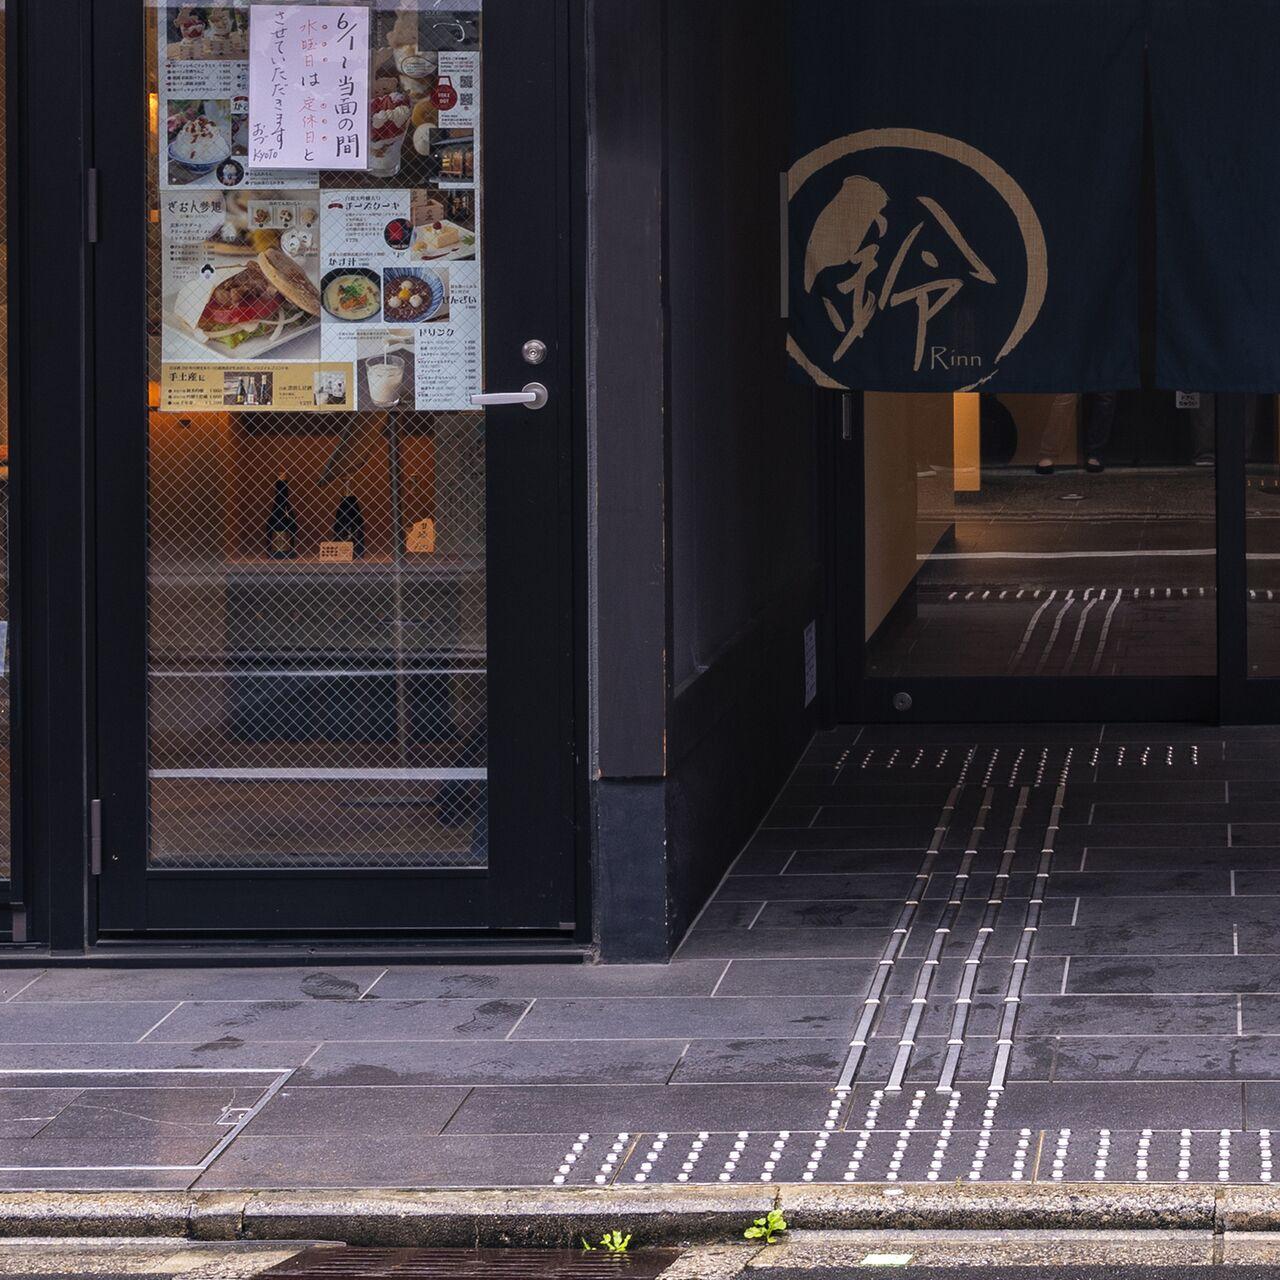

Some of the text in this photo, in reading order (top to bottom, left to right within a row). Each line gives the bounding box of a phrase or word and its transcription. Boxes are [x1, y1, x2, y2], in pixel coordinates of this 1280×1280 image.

[271, 11, 288, 149] させていただきます
[803, 174, 998, 372] 鈴
[419, 328, 454, 337] ドリンク
[931, 346, 983, 371] Rinn
